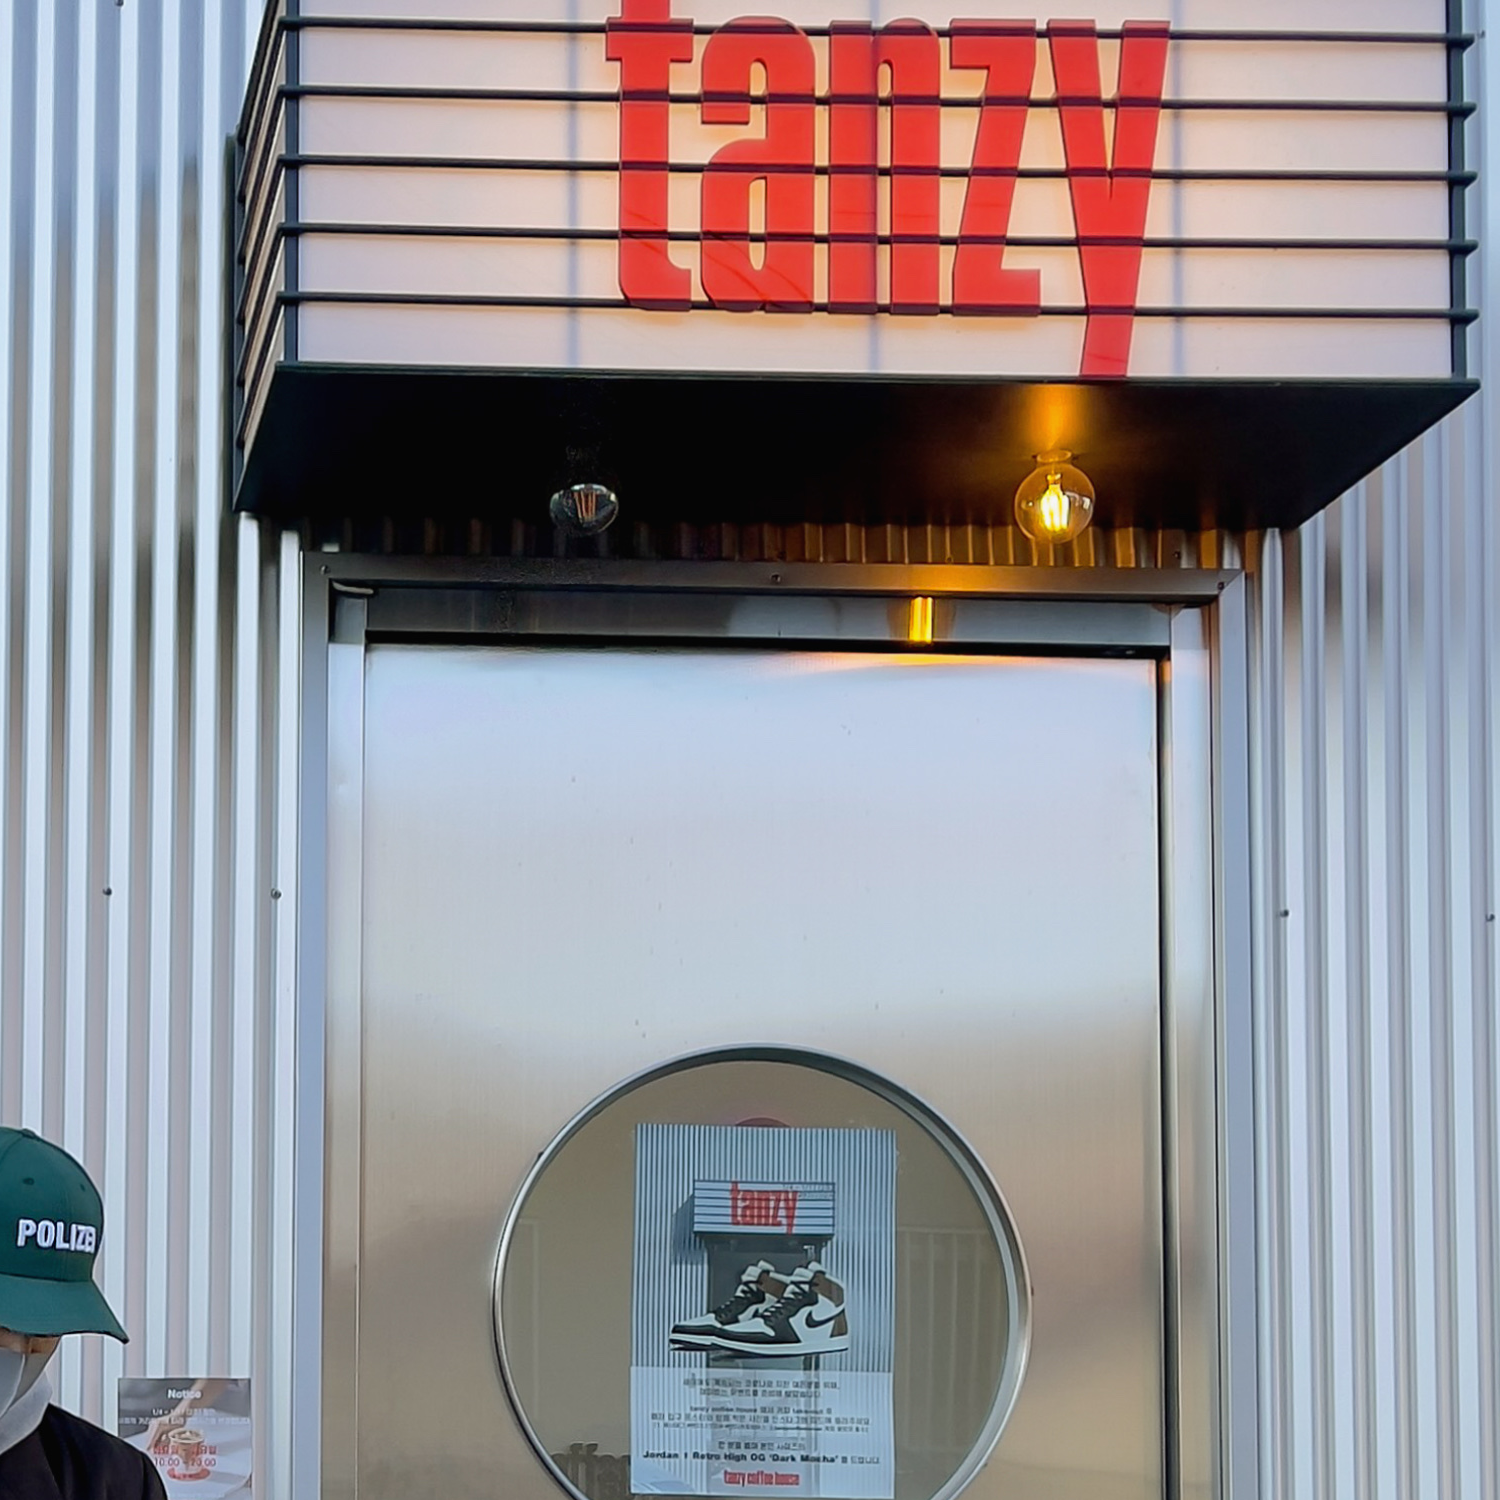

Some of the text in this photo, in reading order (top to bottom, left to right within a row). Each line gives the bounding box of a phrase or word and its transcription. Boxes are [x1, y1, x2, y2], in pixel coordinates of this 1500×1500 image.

[606, 0, 1168, 376] tanzy
[730, 1181, 798, 1235] tanzy
[167, 1389, 202, 1399] Notice
[643, 1451, 679, 1459] Jordan
[692, 1452, 721, 1460] Retro
[723, 1453, 747, 1462] High
[750, 1454, 766, 1462] OG
